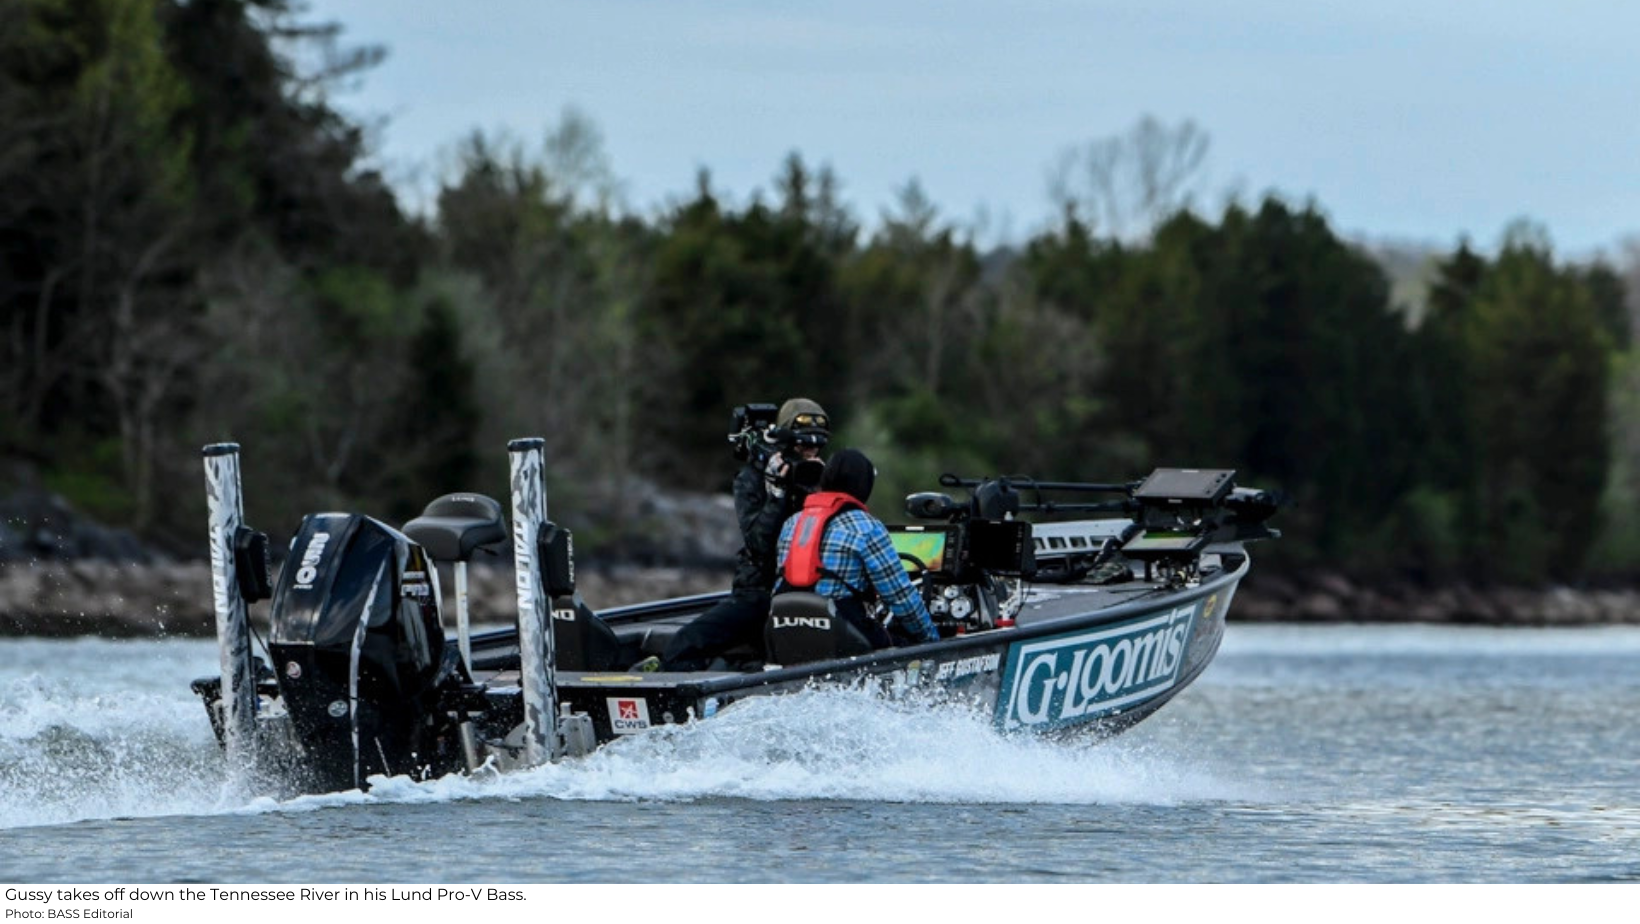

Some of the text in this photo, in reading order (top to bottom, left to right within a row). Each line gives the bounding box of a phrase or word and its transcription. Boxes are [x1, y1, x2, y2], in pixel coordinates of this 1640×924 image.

[513, 521, 532, 609] TALON
[773, 616, 831, 630] LUND
[935, 661, 957, 680] JEFF
[614, 719, 648, 730] CWS
